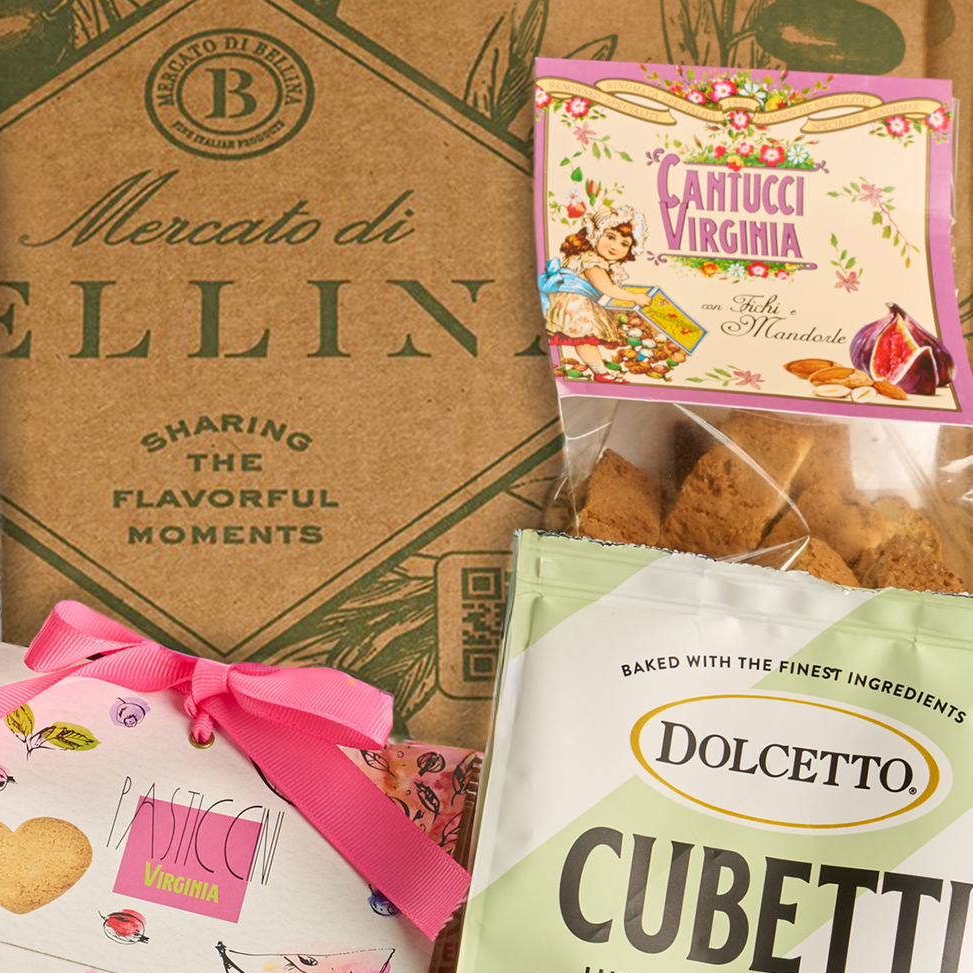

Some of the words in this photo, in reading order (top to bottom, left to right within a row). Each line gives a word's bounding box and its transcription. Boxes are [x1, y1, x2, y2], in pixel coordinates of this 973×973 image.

[157, 39, 217, 107] MERCATO
[225, 36, 249, 51] DI
[253, 42, 303, 106] BELLINA
[607, 81, 659, 100] RINOMATA
[204, 68, 257, 119] B
[549, 81, 601, 101] RENOWNED
[606, 97, 662, 121] SPECIALITY
[727, 99, 752, 109] 1860
[656, 152, 805, 217] CANTUCCI
[19, 170, 321, 247] Mercato
[334, 189, 416, 246] di
[658, 200, 804, 259] VIRGINIA
[701, 302, 723, 312] con
[730, 294, 782, 315] Fichi
[790, 308, 798, 316] e
[720, 314, 848, 345] Mandorle
[140, 413, 313, 453] SHARING
[186, 453, 263, 472] THE
[112, 489, 340, 509] FLAVORFUL
[127, 525, 324, 546] MOMENTS
[621, 654, 680, 678] BAKED
[686, 654, 731, 669] WITH
[738, 655, 773, 672] THE
[779, 659, 843, 682] FINEST
[846, 670, 967, 725] INGREDIENTS
[144, 860, 219, 903] VIRGINIA
